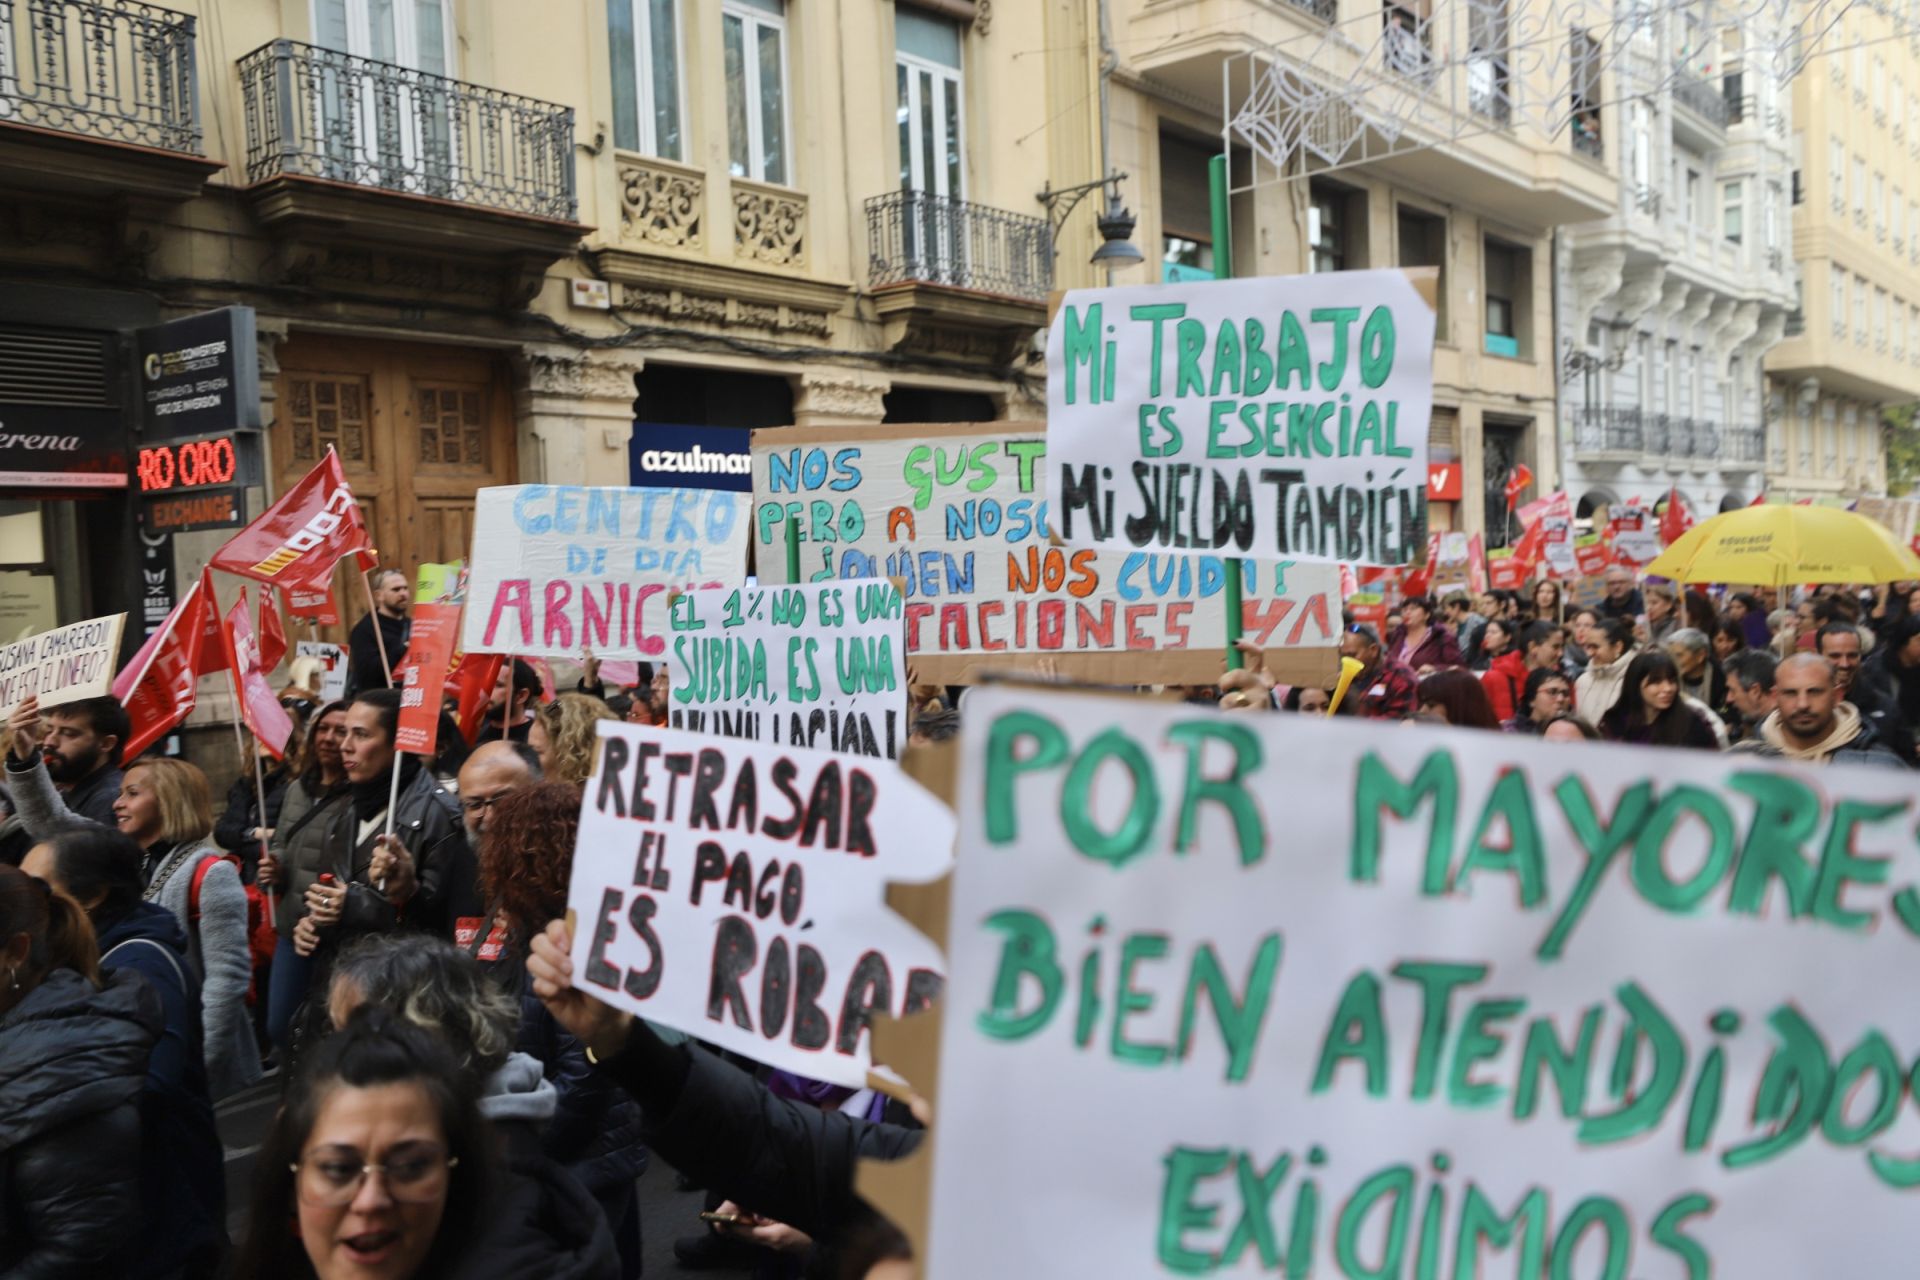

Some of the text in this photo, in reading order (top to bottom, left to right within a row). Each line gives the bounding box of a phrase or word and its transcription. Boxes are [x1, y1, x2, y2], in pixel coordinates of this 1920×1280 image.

[1130, 303, 1396, 398] TRABAJO
[0, 421, 84, 451] erena
[1138, 404, 1183, 458] ES
[178, 438, 236, 487] ORO
[769, 447, 862, 493] NOS
[153, 495, 233, 528] EXCHANGE
[513, 484, 738, 544] CENTRO
[758, 499, 865, 545] PERO
[888, 506, 916, 542] A
[1125, 461, 1256, 552] SUELDO
[567, 543, 606, 577] DE
[1007, 545, 1099, 599] NOS
[671, 583, 900, 631] EL 1% NO ES UNA
[787, 636, 820, 703] ES
[836, 634, 896, 695] UNA
[597, 736, 879, 858] RETRASAR
[983, 709, 1267, 868] POR
[632, 830, 670, 892] EL
[585, 887, 664, 1000] ES
